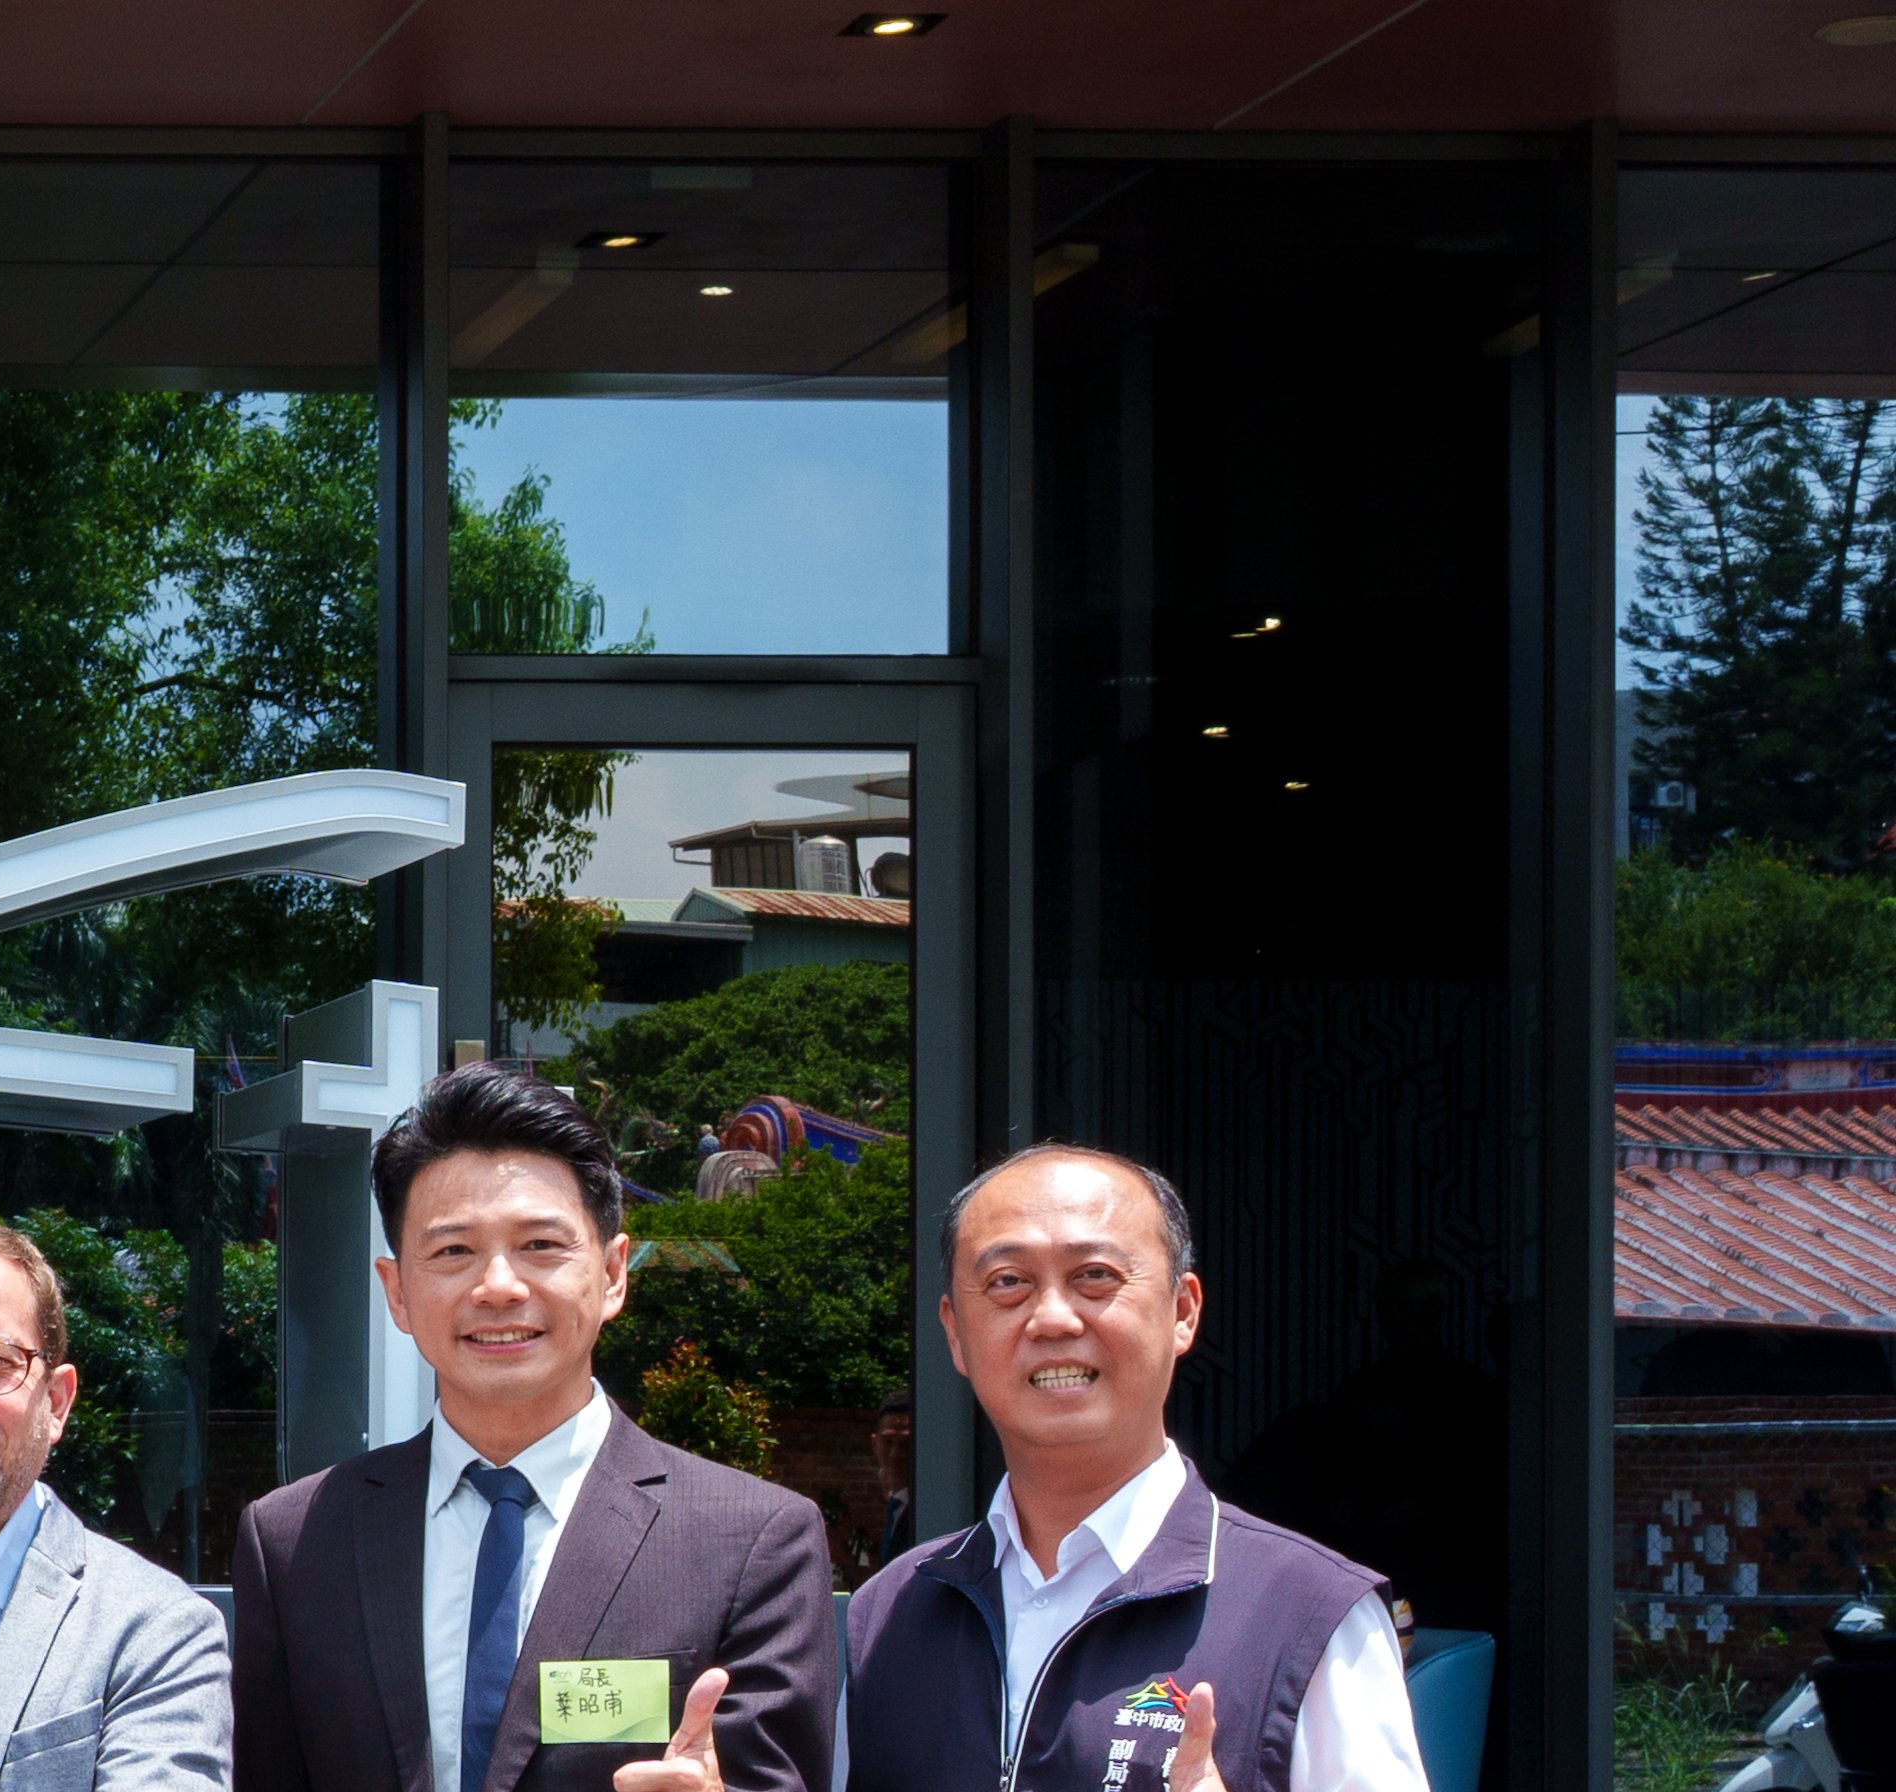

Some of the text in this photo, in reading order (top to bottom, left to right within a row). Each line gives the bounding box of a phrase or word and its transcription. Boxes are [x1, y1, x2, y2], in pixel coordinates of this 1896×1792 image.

[577, 1667, 613, 1688] 局長
[1114, 1708, 1186, 1733] 臺中市政
